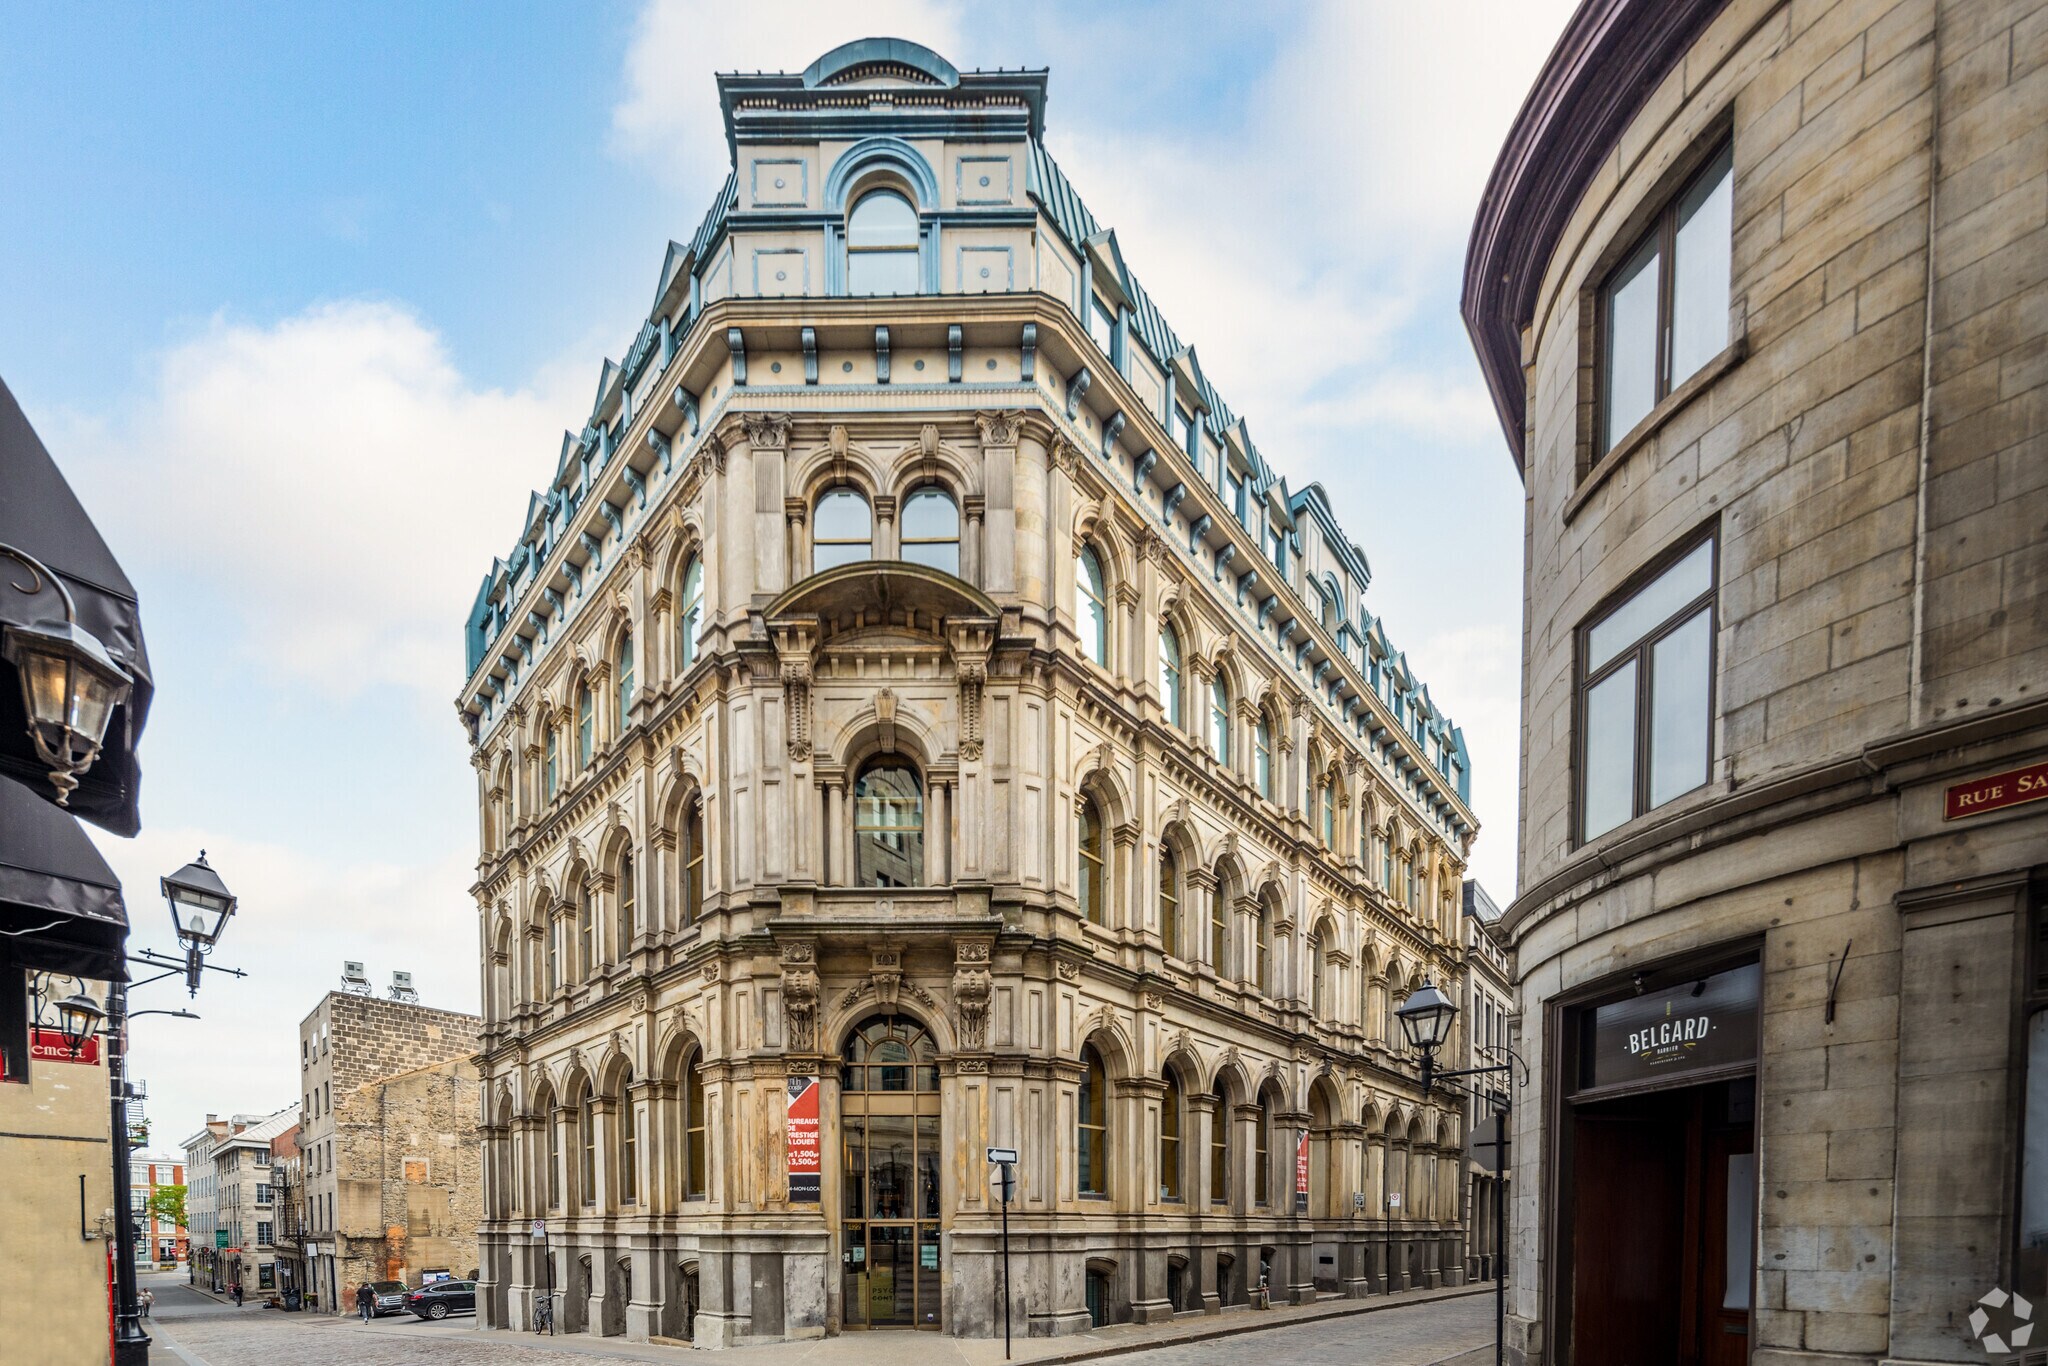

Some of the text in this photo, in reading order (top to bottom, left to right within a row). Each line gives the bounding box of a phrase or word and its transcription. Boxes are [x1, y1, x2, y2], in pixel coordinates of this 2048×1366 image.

[1958, 772, 2048, 807] RUE SA
[1629, 1016, 1709, 1054] BELGARD
